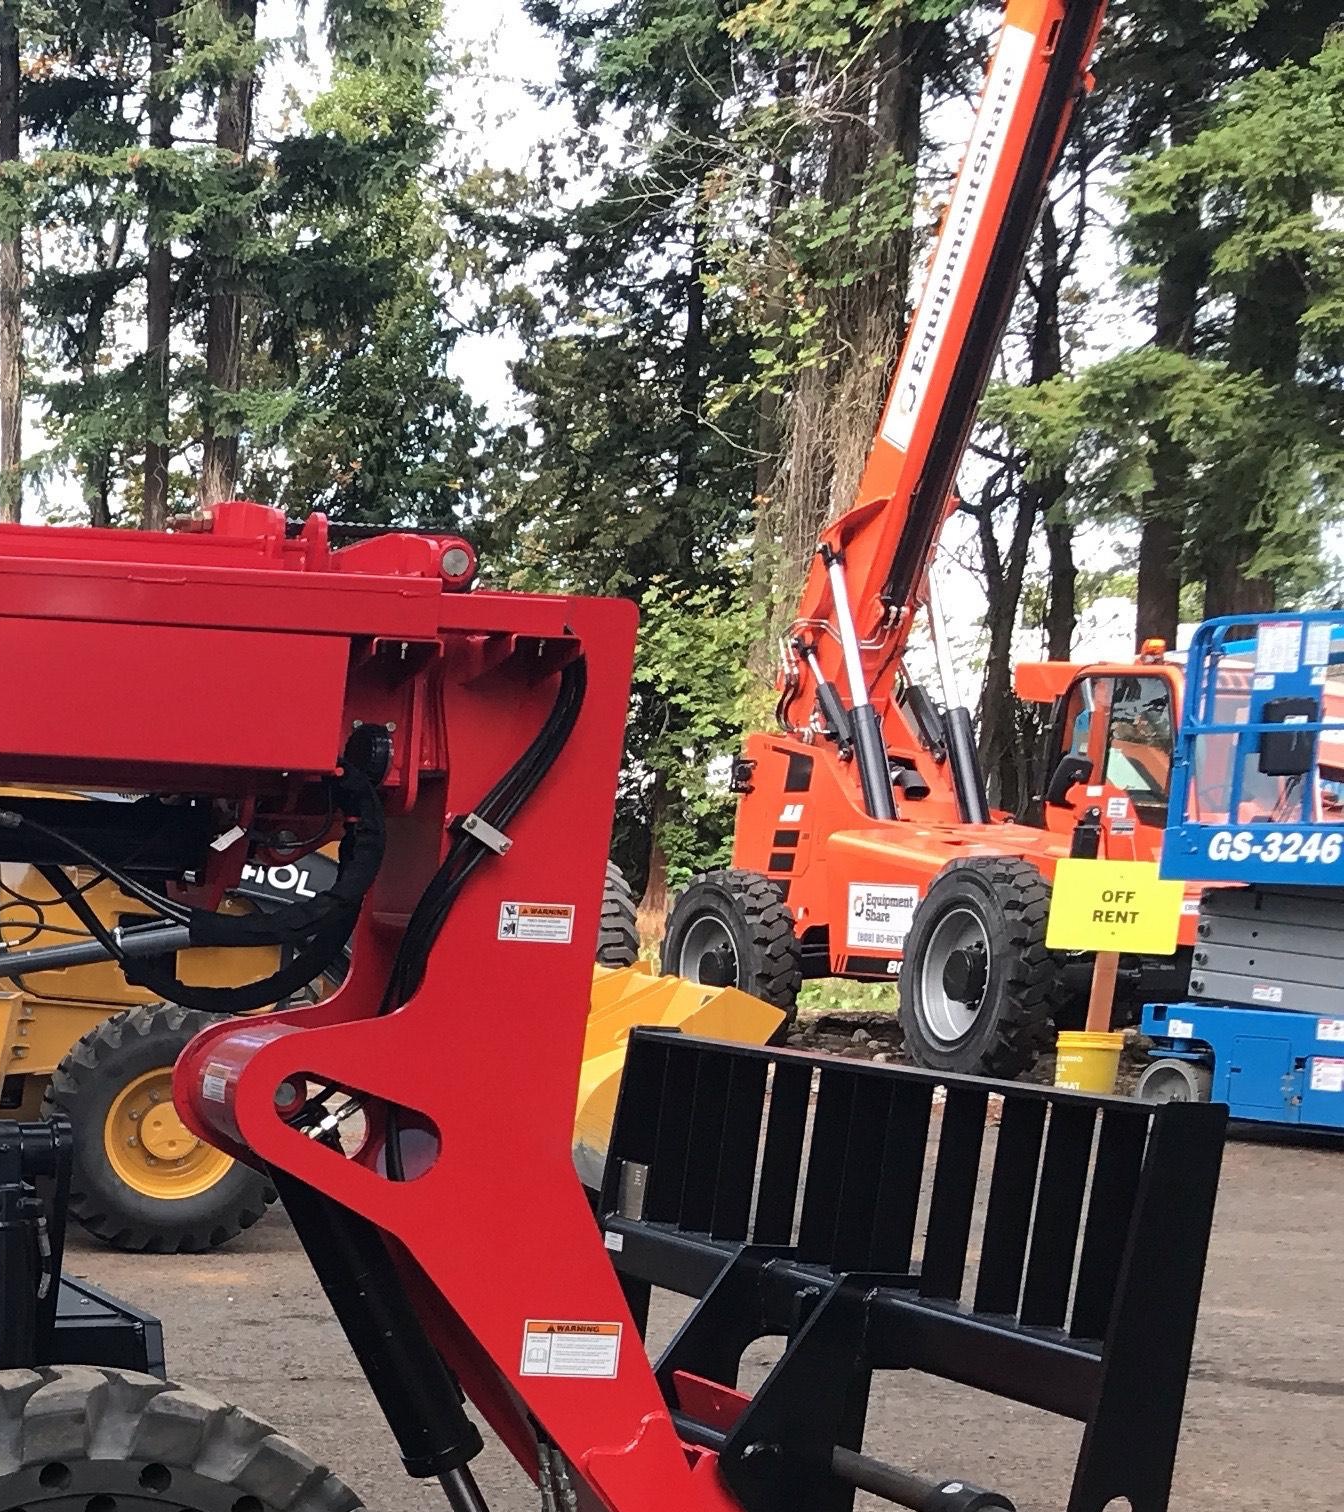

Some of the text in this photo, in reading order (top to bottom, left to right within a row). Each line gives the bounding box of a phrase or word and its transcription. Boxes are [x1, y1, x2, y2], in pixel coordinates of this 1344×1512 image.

[910, 65, 1015, 376] EquipmentShare
[1207, 830, 1344, 865] GS-3246
[865, 892, 914, 909] Equipment
[1101, 889, 1137, 904] OFF
[865, 908, 890, 922] Share
[1091, 909, 1140, 924] RENT
[556, 1325, 600, 1333] WARNING
